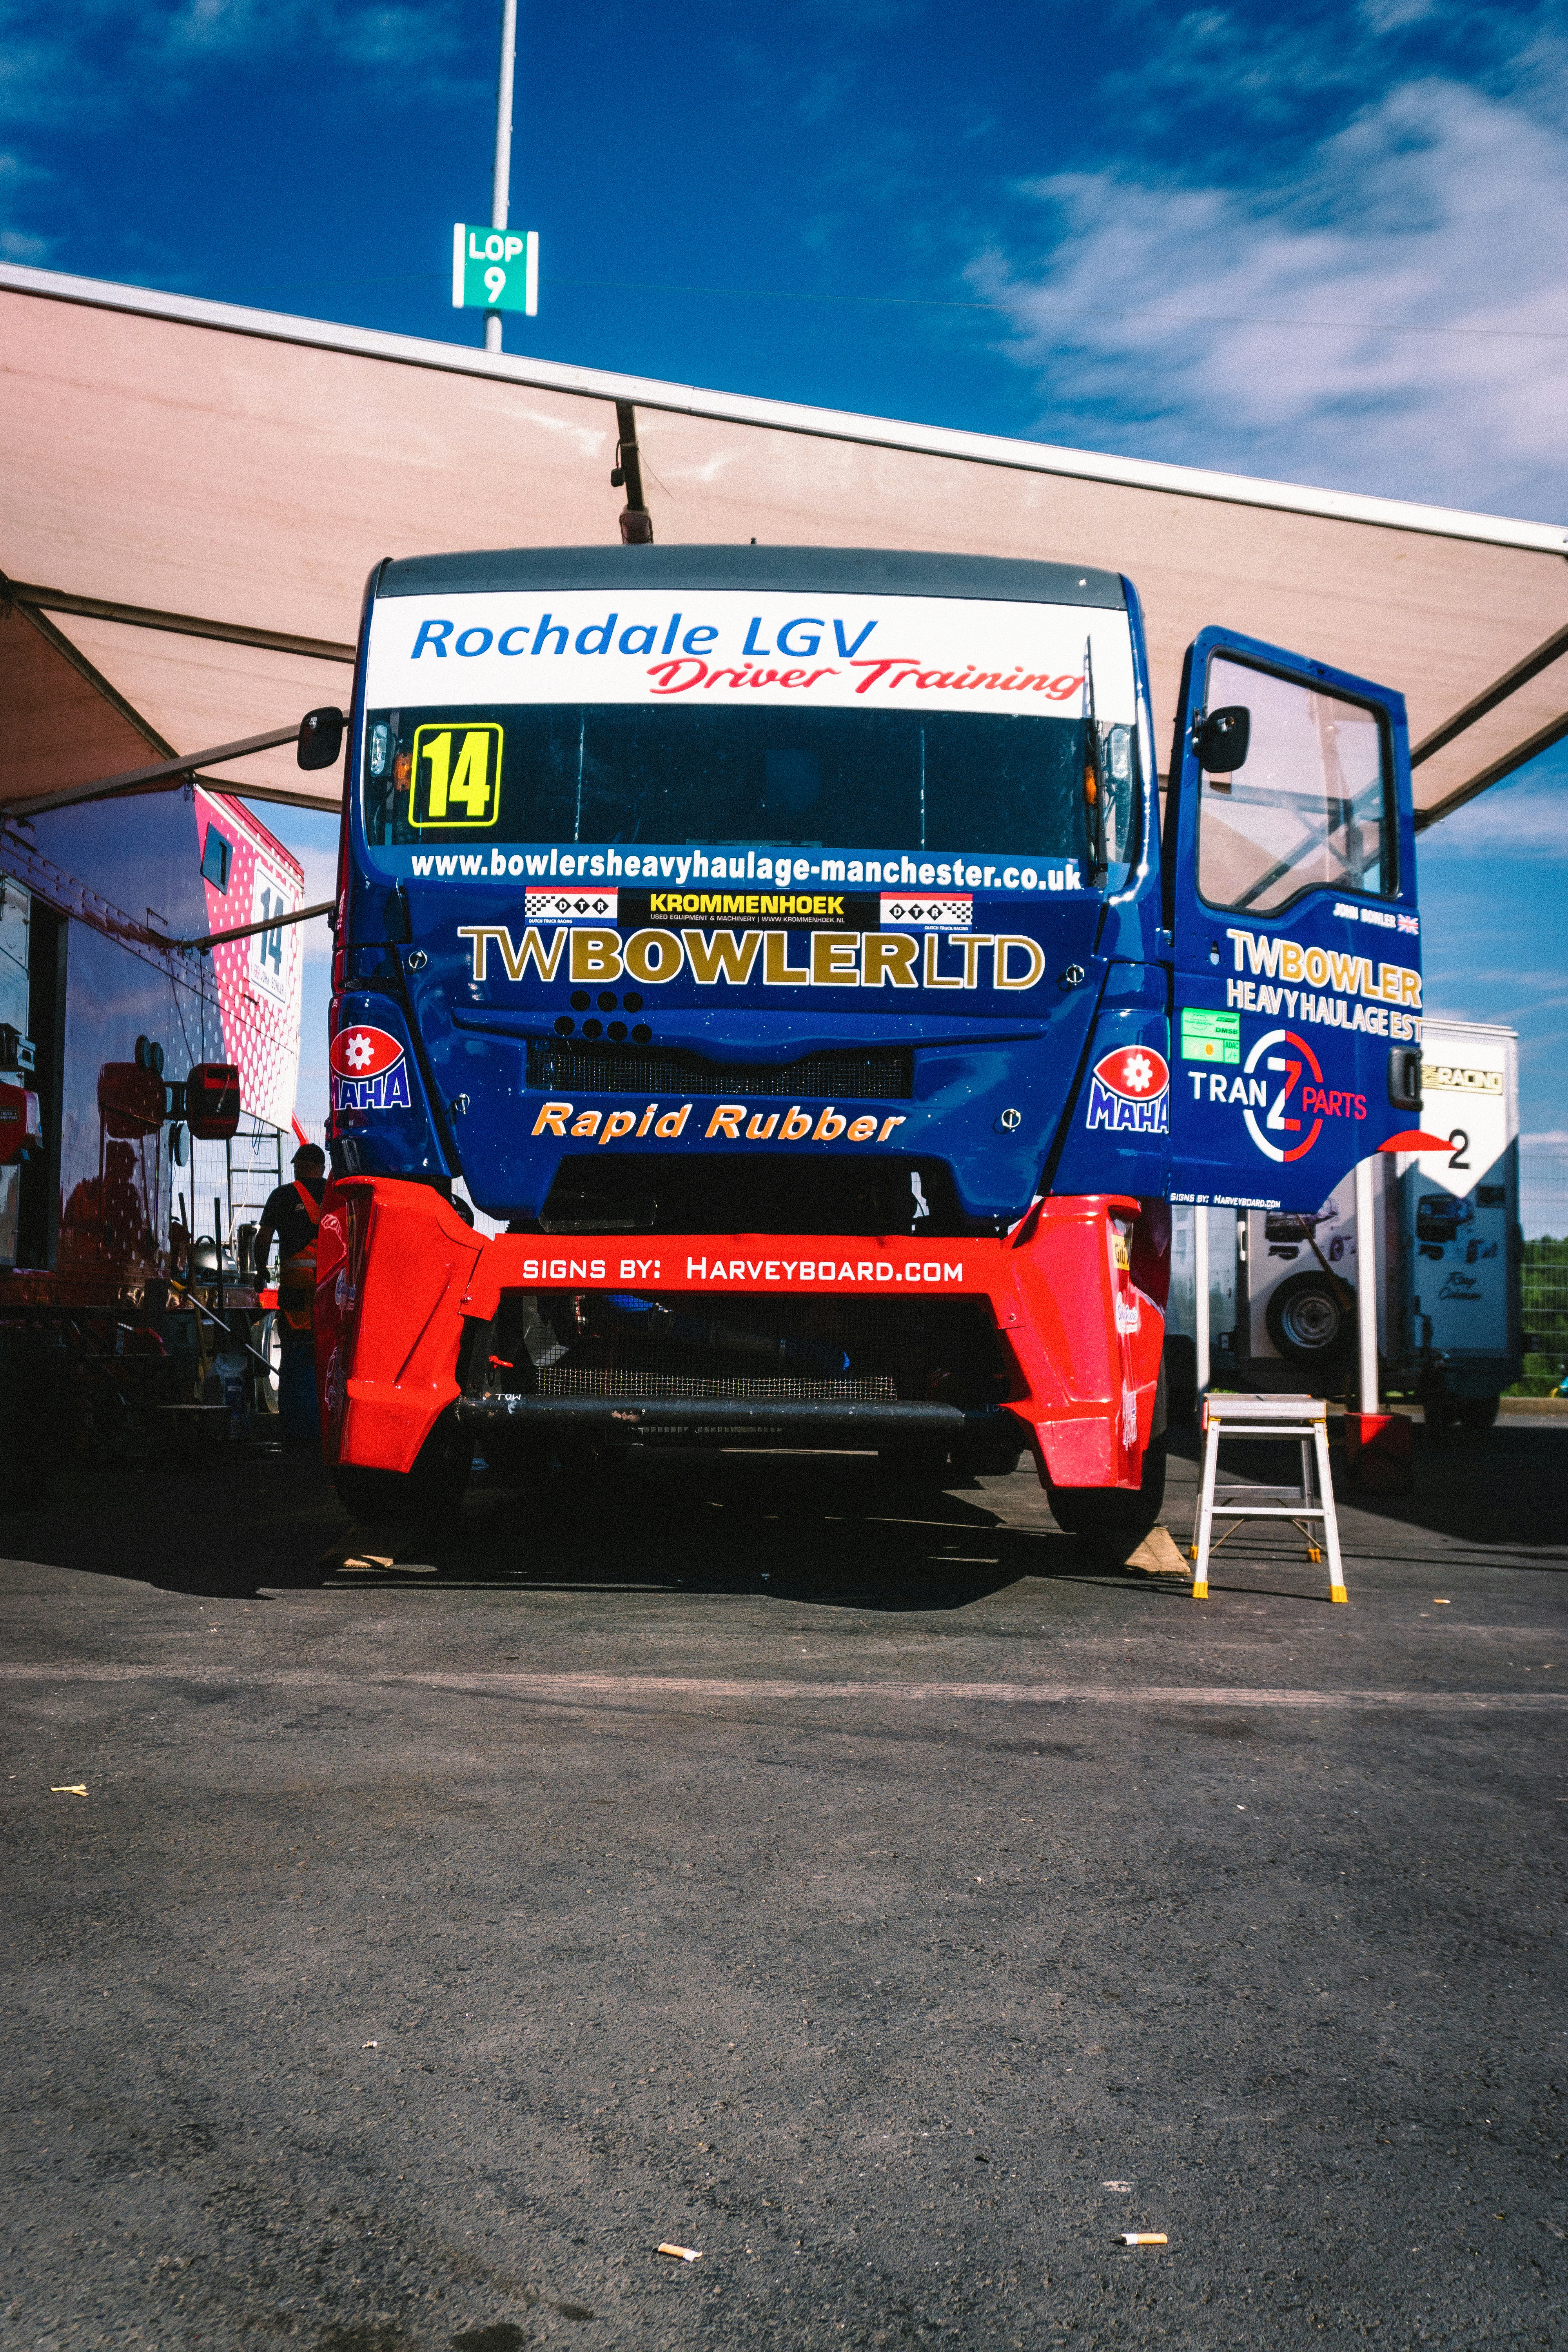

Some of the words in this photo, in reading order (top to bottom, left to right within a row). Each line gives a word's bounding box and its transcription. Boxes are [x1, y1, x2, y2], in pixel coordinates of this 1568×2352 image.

[469, 232, 523, 262] LOP
[484, 266, 506, 303] 9
[411, 613, 719, 659] Rochdale
[742, 617, 878, 658] LGV
[647, 657, 842, 694] Driver
[850, 659, 1085, 701] Training
[422, 731, 490, 817] 14
[411, 848, 1082, 890] www.bowlersheavyhaulage-manchester.co.uk
[650, 893, 844, 915] KROMMENHOEK
[260, 887, 284, 976] 14
[1225, 1041, 1239, 1049] ADAC
[531, 1102, 693, 1145] Rapid
[705, 1104, 906, 1142] Rubber
[1085, 1076, 1170, 1134] MAHA
[1448, 1129, 1470, 1169] 2
[1170, 1192, 1195, 1202] SIGNS
[1196, 1194, 1209, 1203] BY:
[523, 1259, 606, 1279] SIGNS
[620, 1259, 661, 1279] BY:
